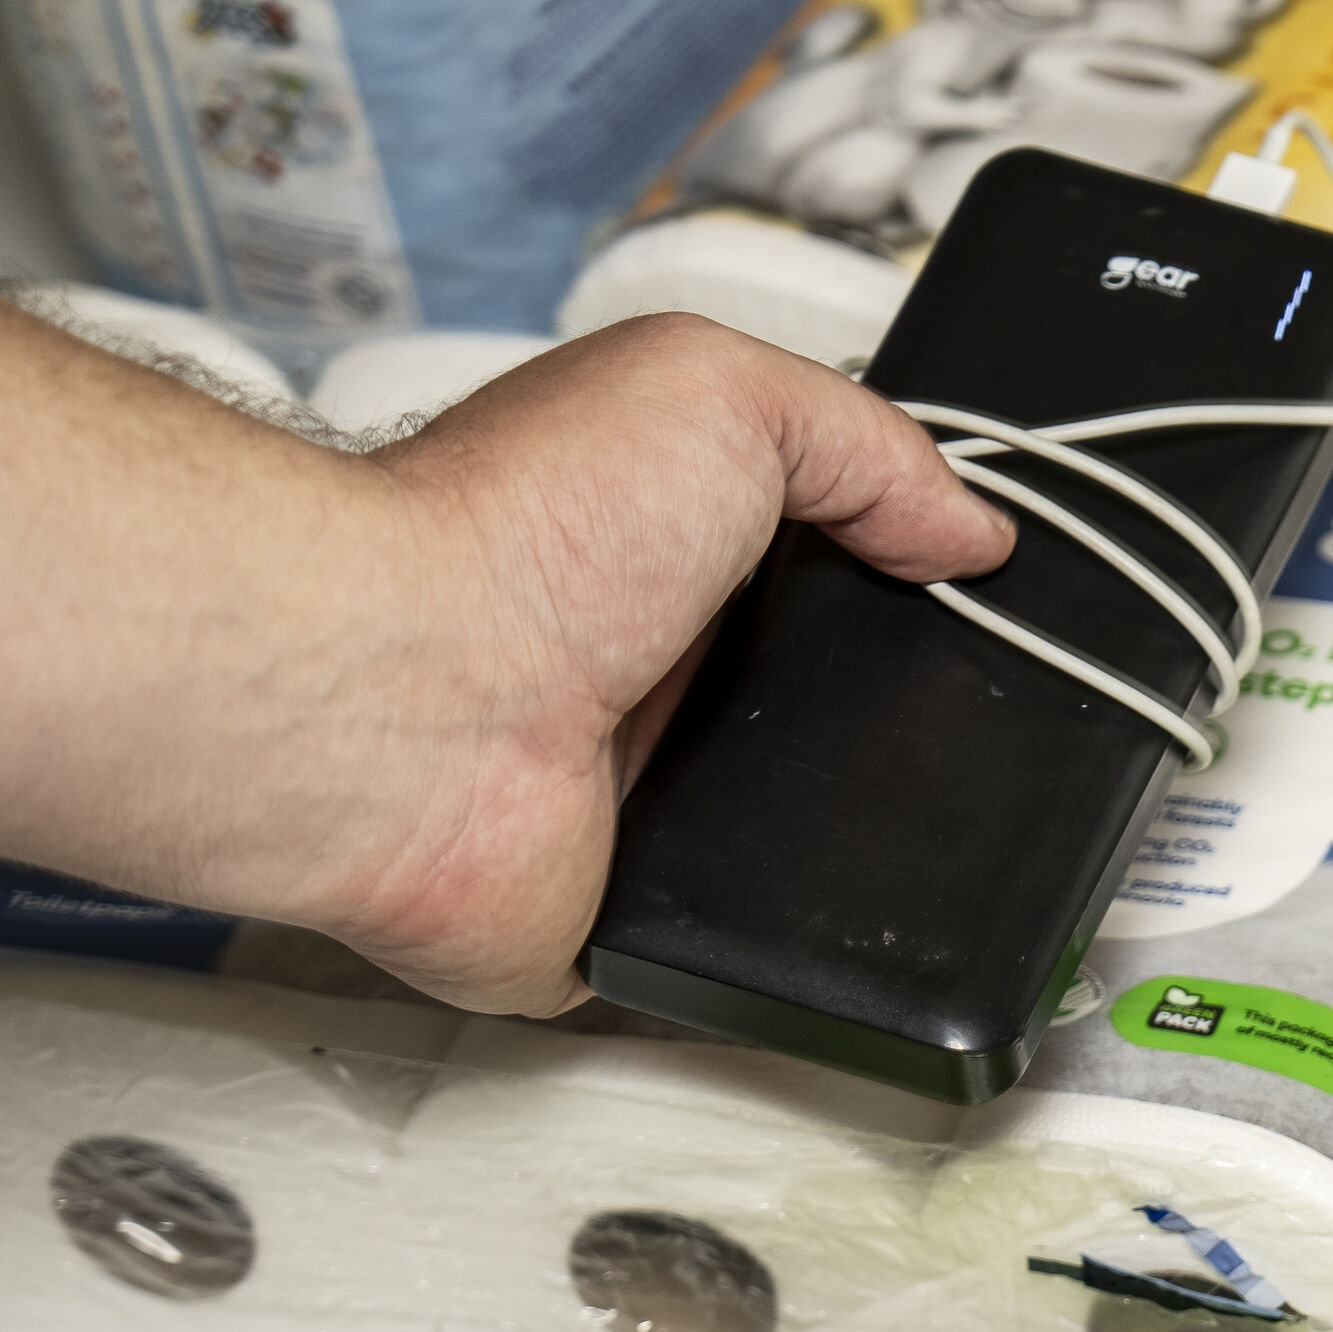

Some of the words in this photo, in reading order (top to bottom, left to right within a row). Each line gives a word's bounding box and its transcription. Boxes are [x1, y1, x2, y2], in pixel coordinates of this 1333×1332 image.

[1100, 256, 1200, 290] gear
[1153, 1011, 1212, 1036] PACK
[1244, 1009, 1276, 1028] This
[1236, 1025, 1253, 1037] of
[1254, 1028, 1310, 1053] mostly
